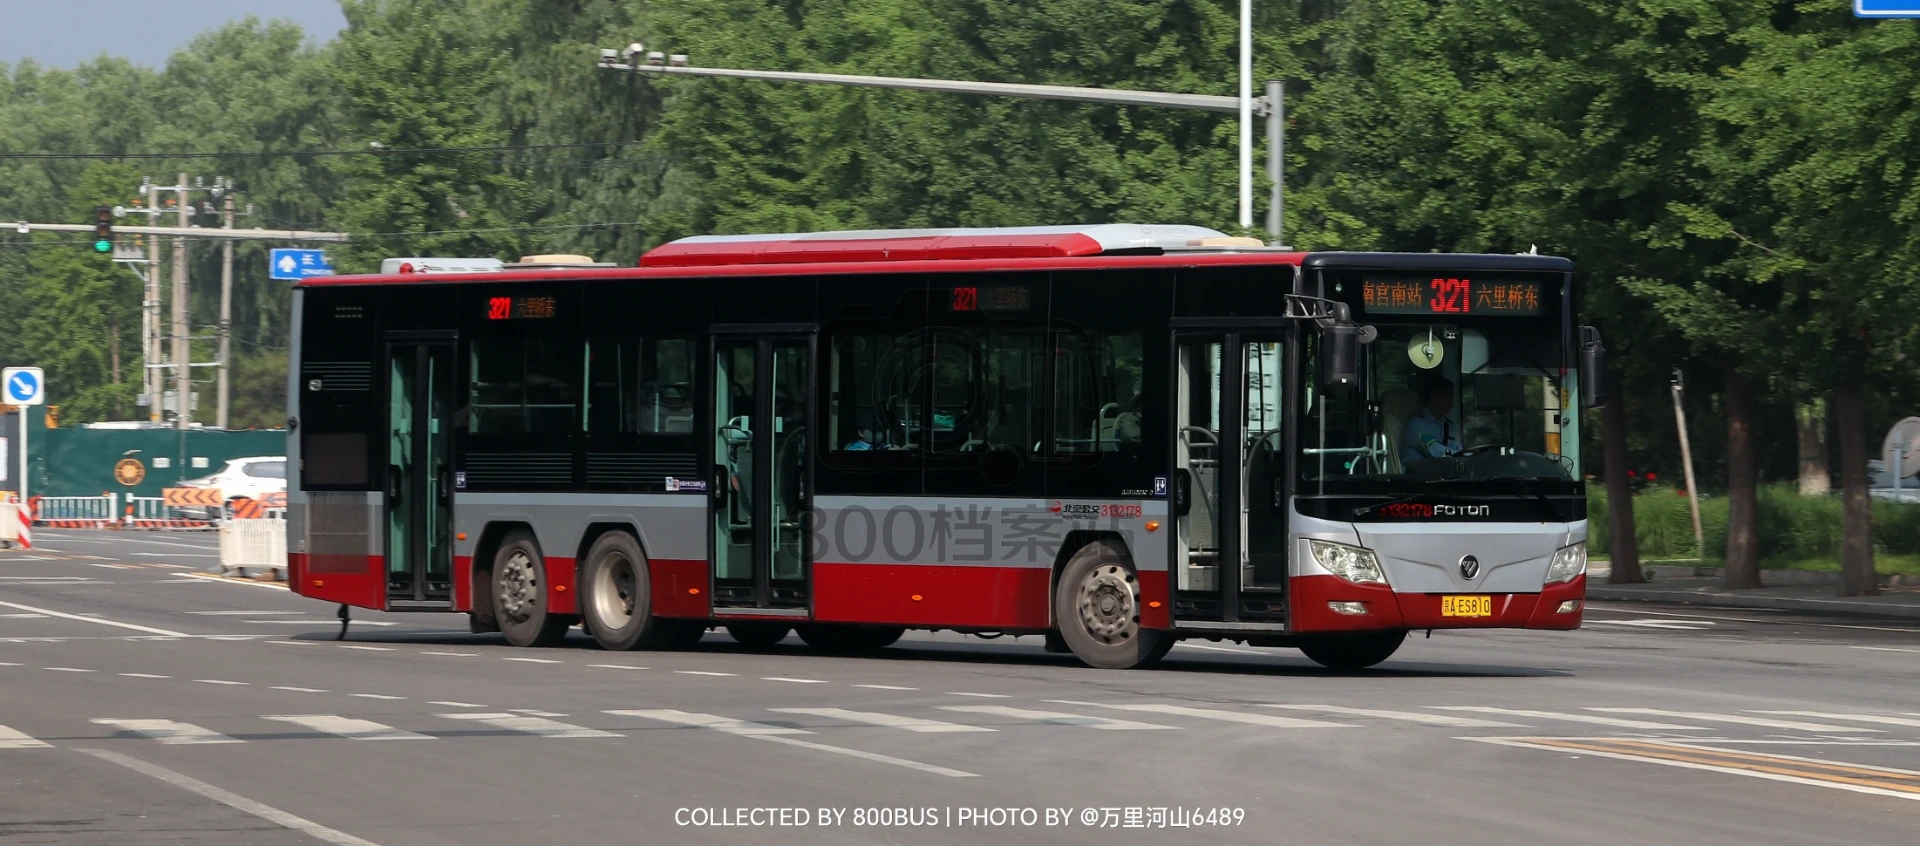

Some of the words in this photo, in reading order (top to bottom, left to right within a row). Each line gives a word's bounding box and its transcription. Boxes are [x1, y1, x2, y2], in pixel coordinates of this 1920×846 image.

[953, 287, 977, 310] 321
[1363, 281, 1422, 307] 南宫南站
[1430, 278, 1471, 312] 321
[1476, 284, 1538, 310] 六里桥东
[488, 297, 511, 319] 321
[1063, 504, 1100, 514] 北京公交
[1101, 504, 1142, 518] 3132178
